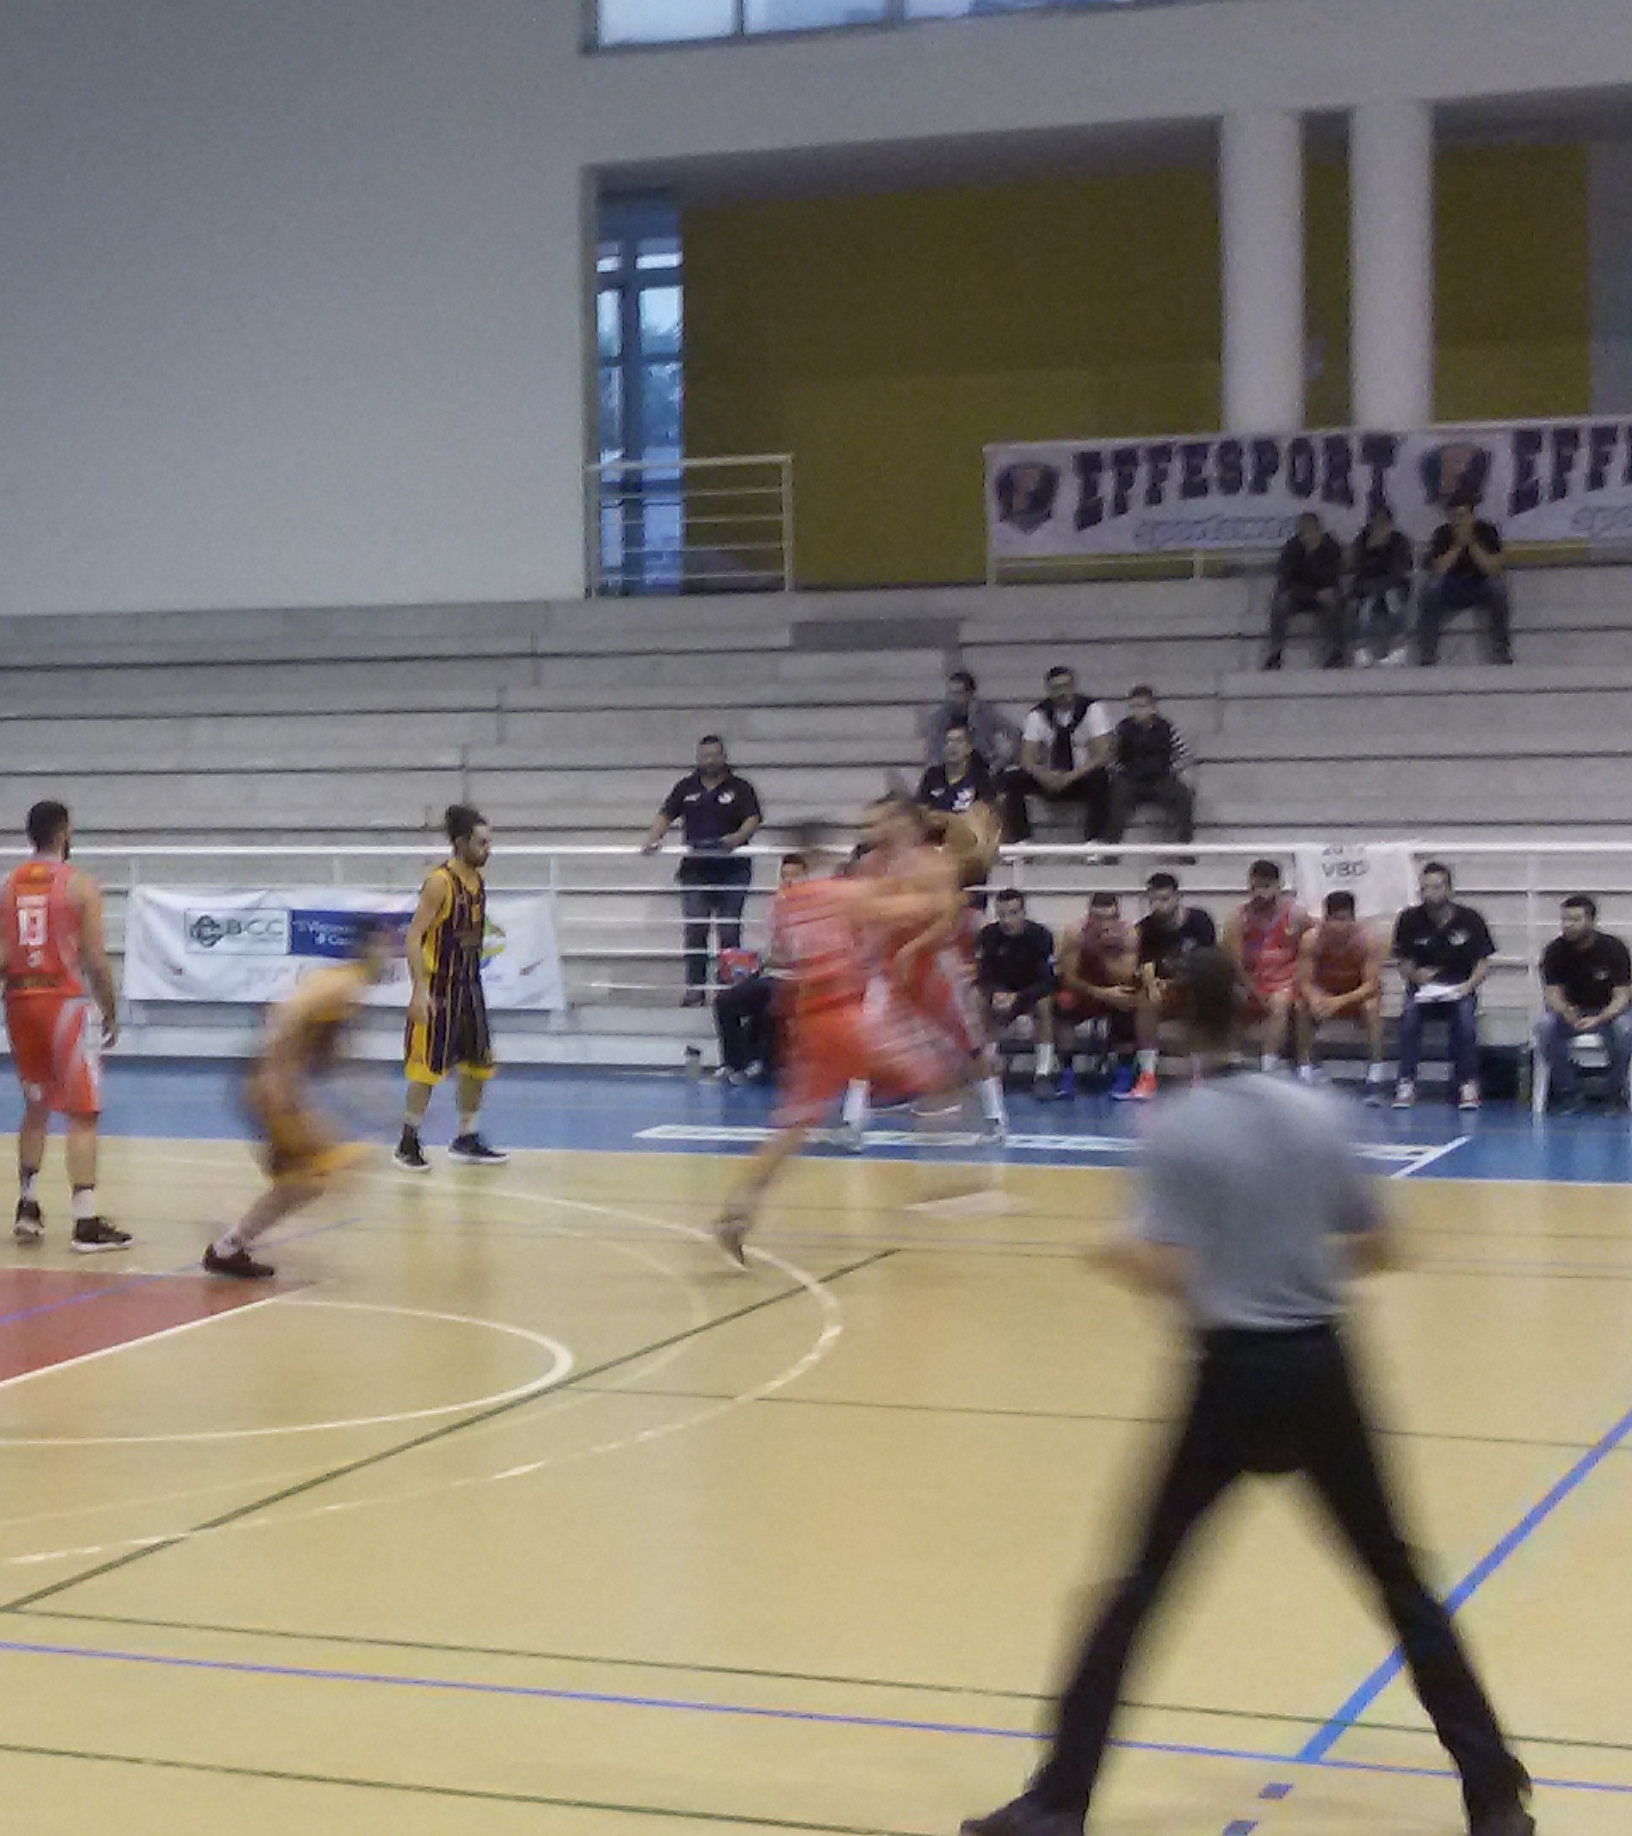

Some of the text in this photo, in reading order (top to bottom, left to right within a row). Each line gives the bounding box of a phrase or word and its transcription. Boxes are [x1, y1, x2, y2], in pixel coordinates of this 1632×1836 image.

[1072, 433, 1398, 530] EFFESPORT
[1508, 425, 1632, 517] EFF
[226, 918, 285, 936] BCC
